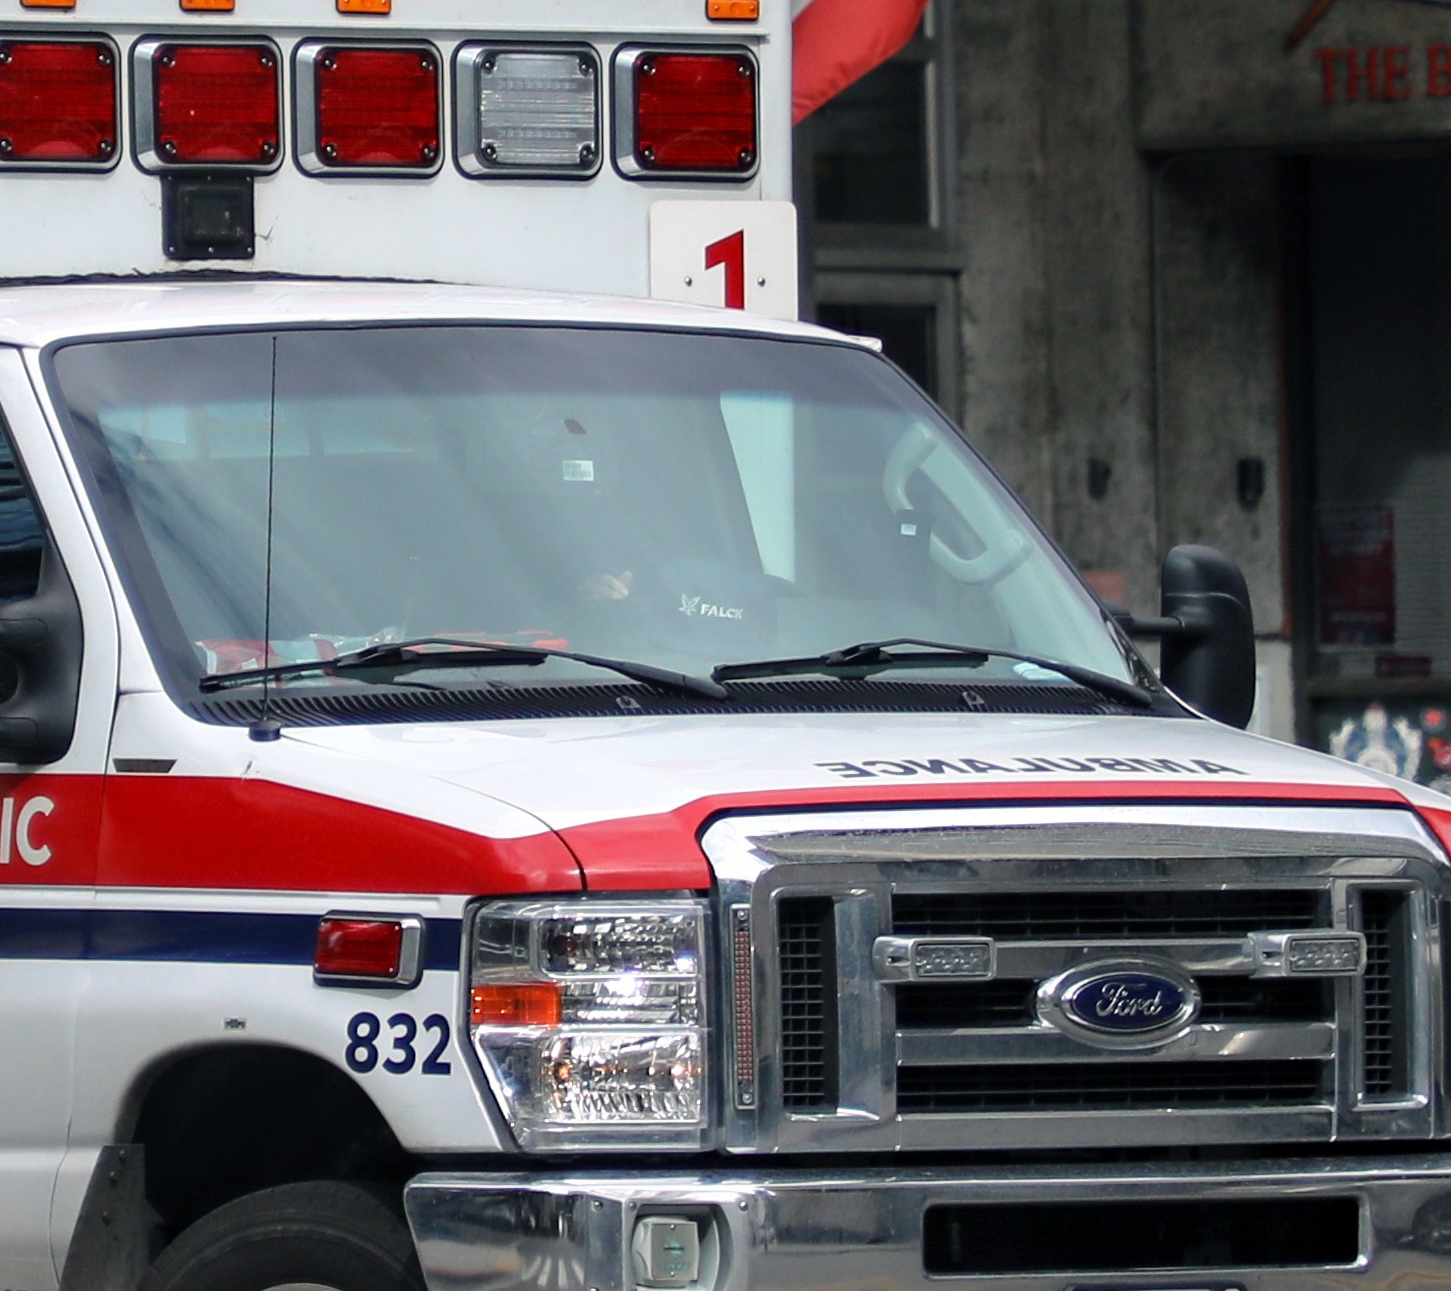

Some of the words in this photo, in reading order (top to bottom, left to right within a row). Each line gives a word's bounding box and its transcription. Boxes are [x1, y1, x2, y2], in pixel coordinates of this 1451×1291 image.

[1312, 44, 1412, 103] THE
[705, 229, 745, 310] 1
[700, 603, 744, 620] FALCK
[1097, 982, 1163, 1018] Ford
[346, 1011, 452, 1076] 832
